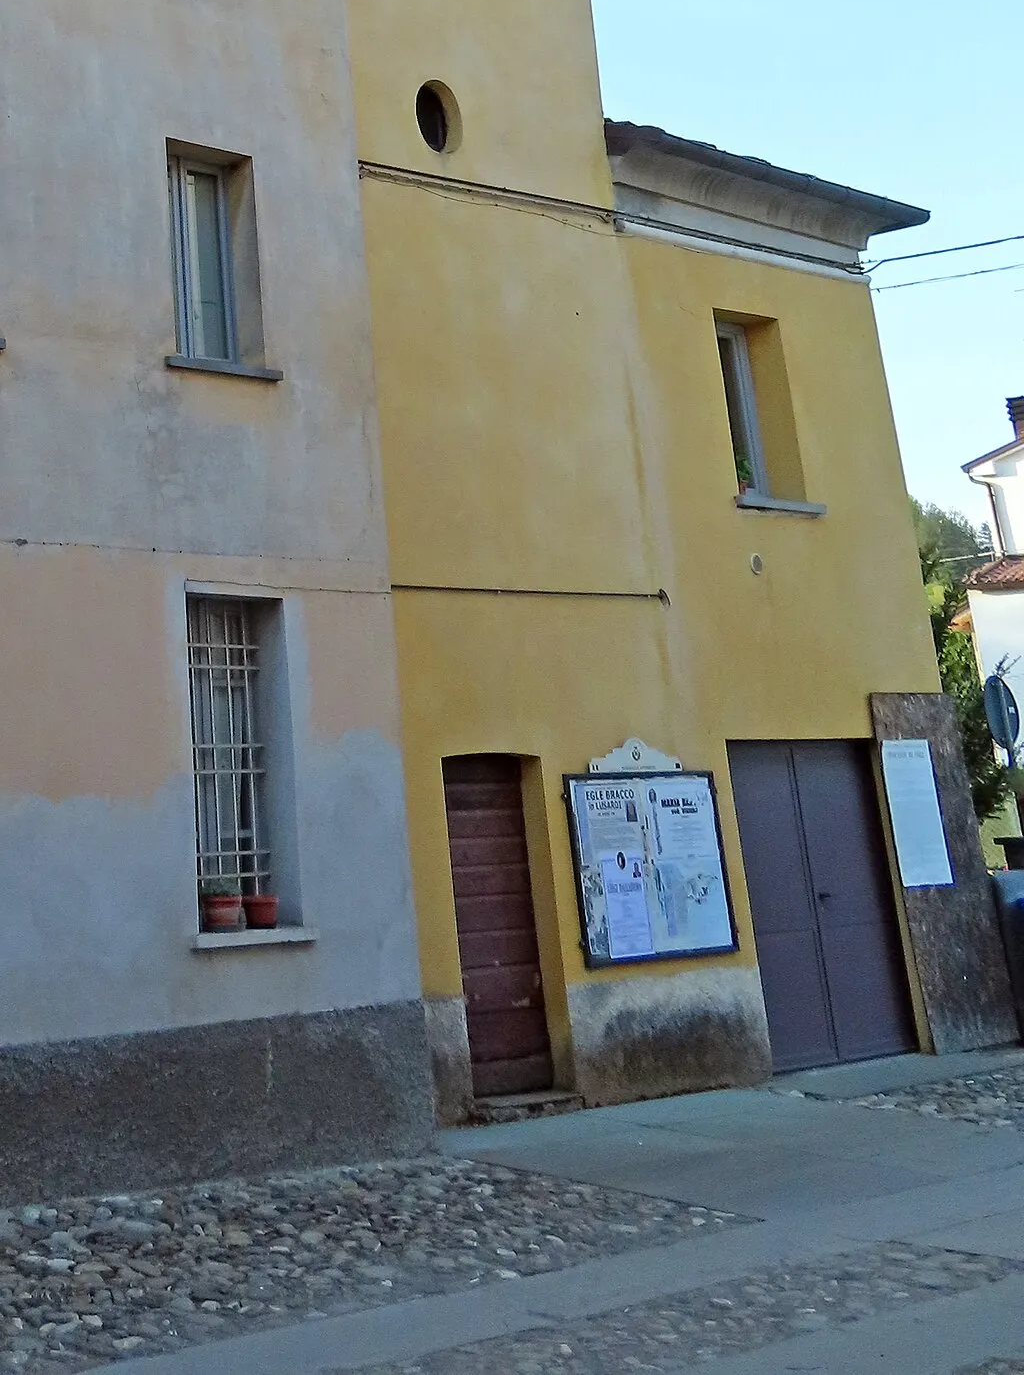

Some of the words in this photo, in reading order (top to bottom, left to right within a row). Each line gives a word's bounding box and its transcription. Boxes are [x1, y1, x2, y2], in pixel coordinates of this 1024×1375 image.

[585, 790, 604, 801] EGLE
[605, 788, 635, 801] BRACCO
[595, 800, 622, 810] LUSARDI
